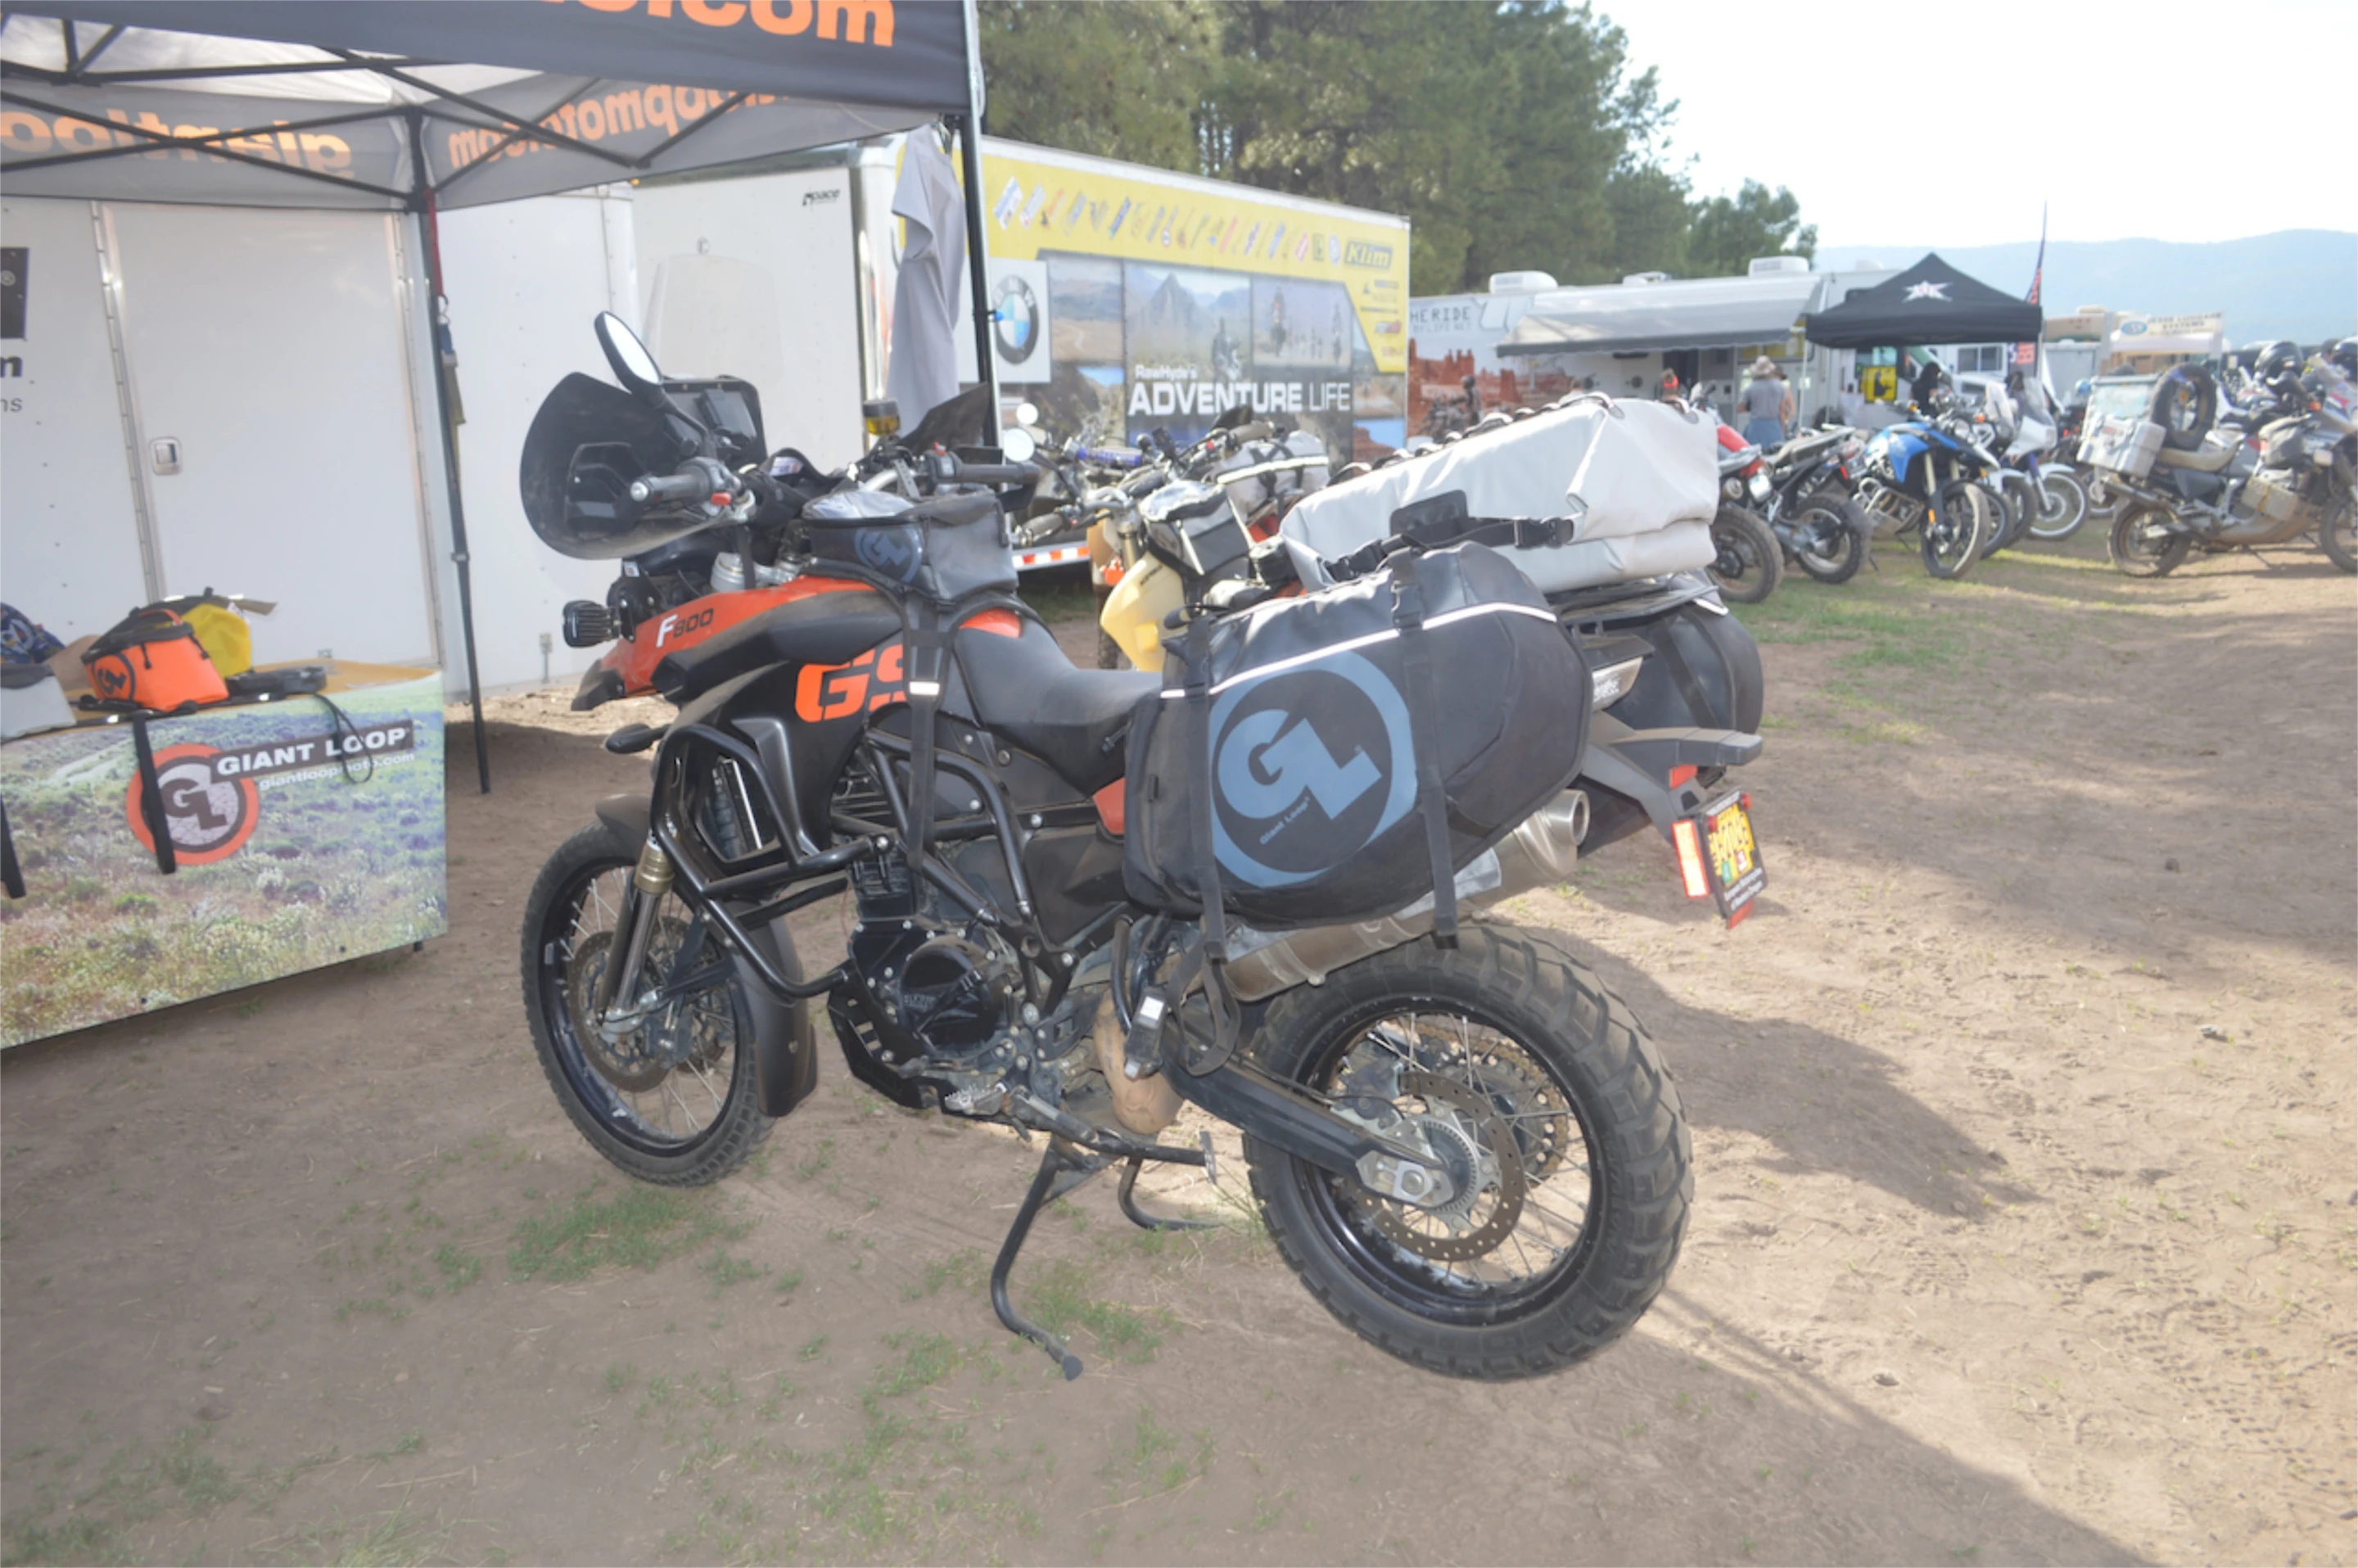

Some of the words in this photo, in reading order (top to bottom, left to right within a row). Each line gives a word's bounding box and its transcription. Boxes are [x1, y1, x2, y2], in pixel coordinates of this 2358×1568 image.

[1431, 306, 1471, 322] RIDE
[1127, 381, 1303, 416] ADVENTURE
[1309, 382, 1350, 410] LIFE
[656, 608, 715, 648] F800
[217, 743, 314, 775] GIANT
[325, 727, 407, 757] LOOP
[1217, 708, 1383, 820] GL
